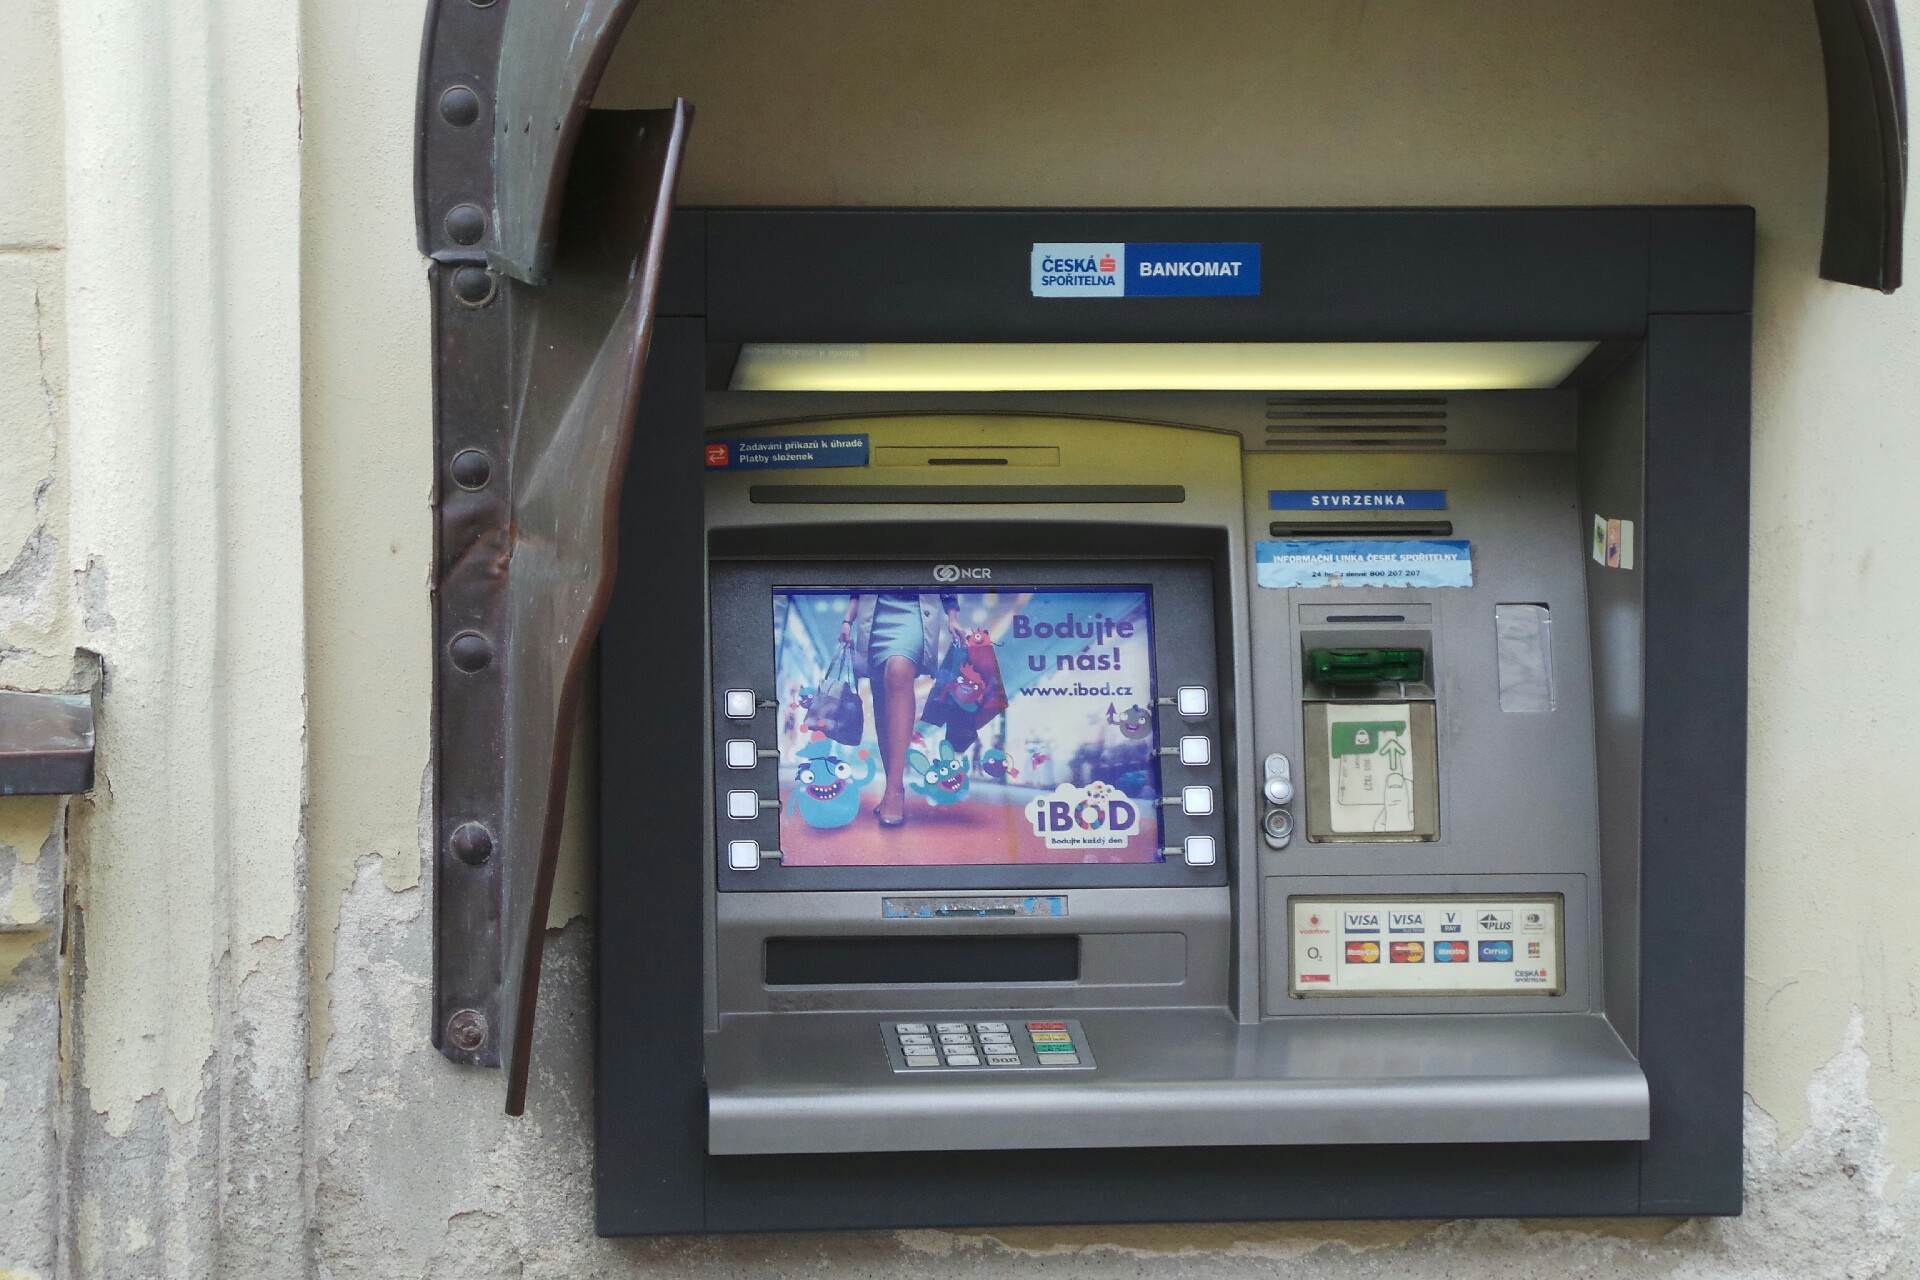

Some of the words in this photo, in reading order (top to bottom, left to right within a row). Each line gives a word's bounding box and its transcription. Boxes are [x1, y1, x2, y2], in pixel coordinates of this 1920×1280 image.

[1042, 255, 1097, 272] ČESKÁ
[1139, 261, 1242, 276] BANKOMAT
[1042, 274, 1115, 286] SPOŘITELNA
[739, 442, 782, 452] Zadávání
[785, 440, 818, 451] příkazů
[821, 440, 828, 448] k
[739, 454, 769, 463] Platby
[772, 452, 814, 461] složenek
[1312, 495, 1405, 506] STVRZENKA
[1274, 553, 1333, 563] INFORMAČNÍ
[1336, 554, 1365, 563] LINKA
[1400, 553, 1458, 562] SPOŘITELNY
[961, 568, 991, 578] NCR
[1013, 613, 1134, 645] Bodujte
[1028, 655, 1046, 671] u
[1056, 646, 1121, 671] nás!
[1020, 682, 1133, 696] www.ibod.cz
[1037, 799, 1135, 832] iBOD
[1051, 837, 1080, 845] Bodujte
[1348, 915, 1378, 925] VISA
[1392, 914, 1423, 925] VISA
[1446, 912, 1456, 923] V
[1489, 921, 1511, 930] PLUS
[1483, 947, 1508, 955] Cirrus
